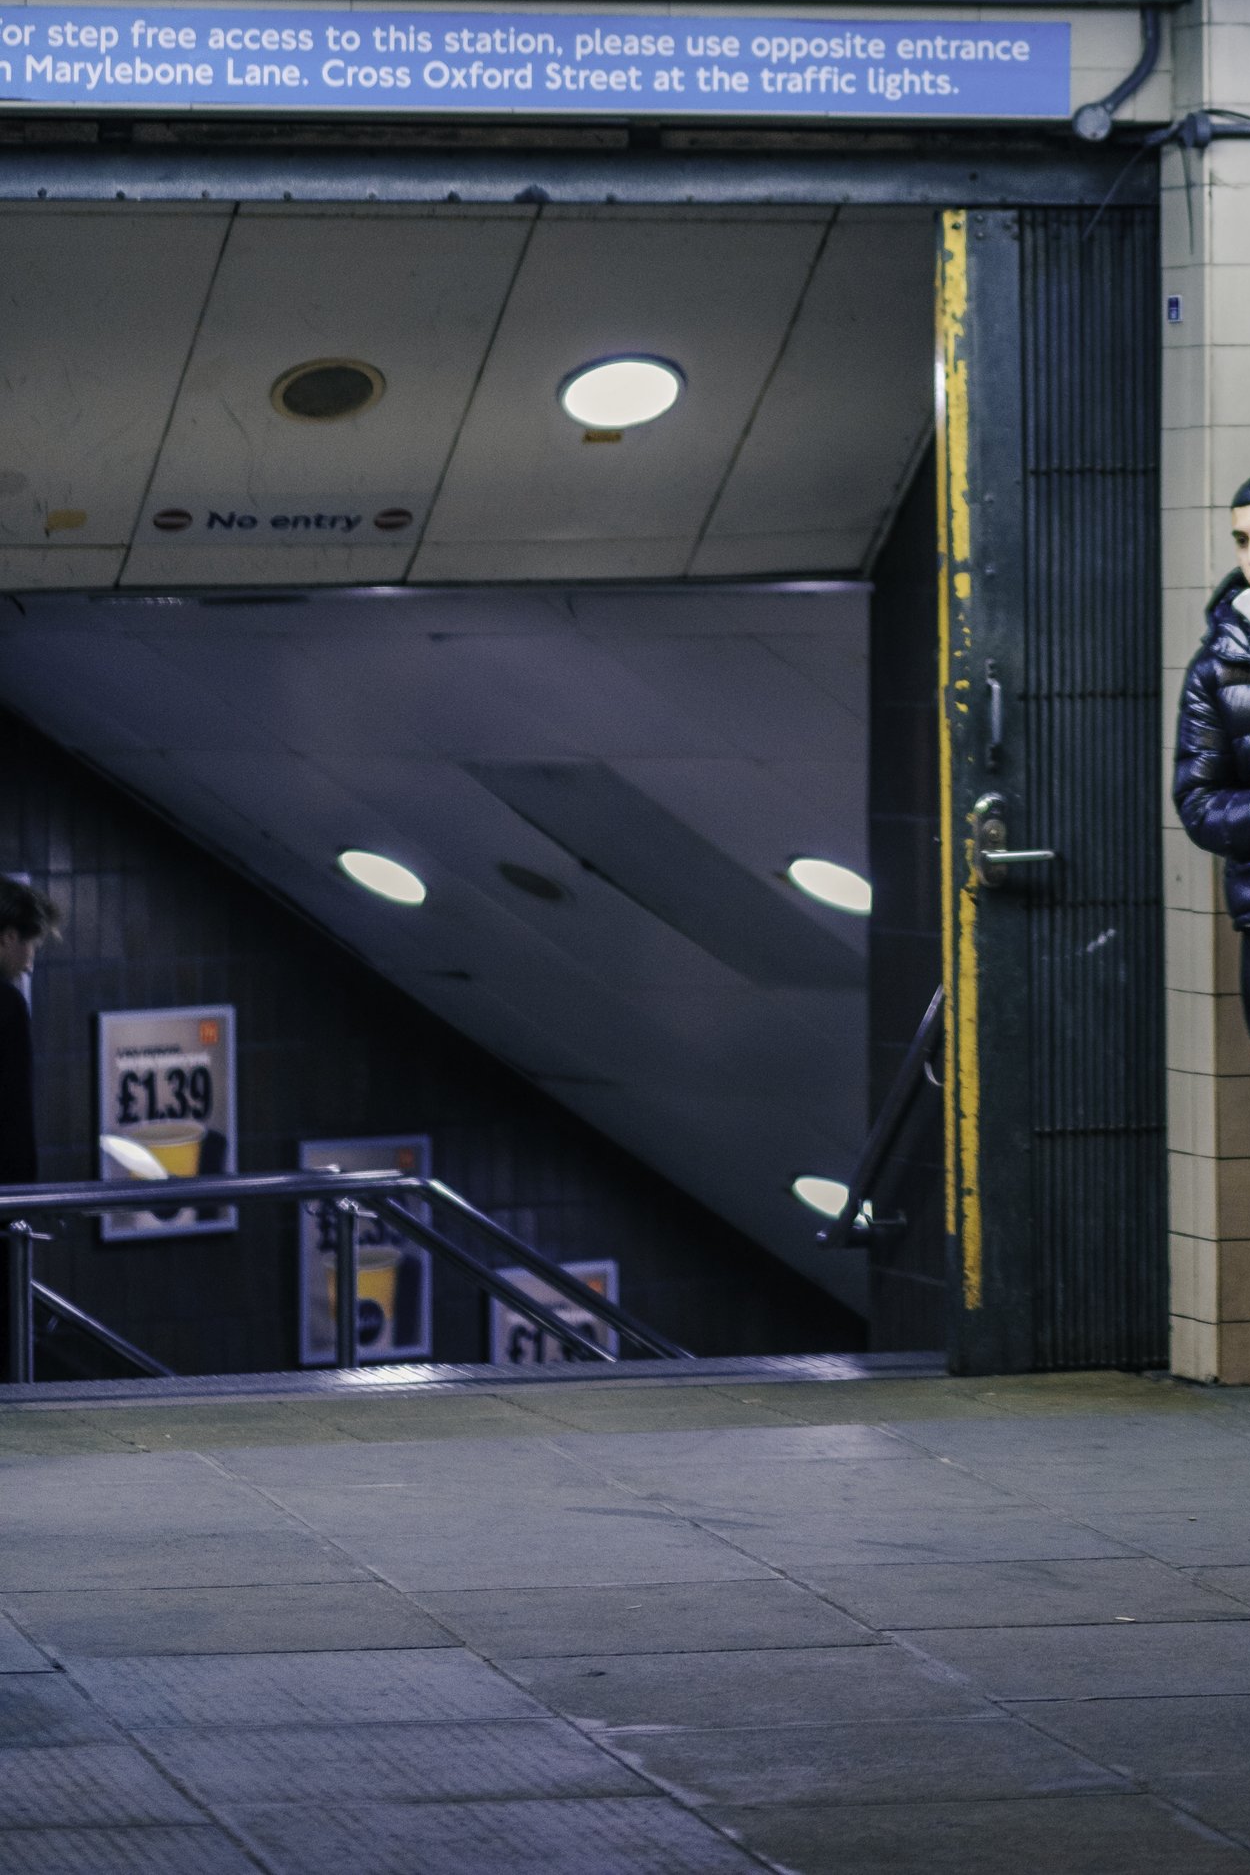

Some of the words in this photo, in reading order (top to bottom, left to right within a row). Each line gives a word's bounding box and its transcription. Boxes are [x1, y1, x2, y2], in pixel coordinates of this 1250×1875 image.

[48, 22, 119, 54] step
[131, 20, 197, 49] free
[208, 27, 314, 51] access
[325, 27, 361, 51] to
[372, 25, 433, 53] this
[444, 27, 563, 58] station,
[575, 28, 675, 62] please
[686, 36, 740, 60] use
[751, 33, 885, 69] opposite
[897, 36, 1029, 62] entrance
[25, 54, 214, 91] Marylebone
[227, 57, 309, 87] Lane.
[321, 59, 411, 88] Cross
[423, 60, 533, 90] Oxford
[545, 62, 642, 91] Street
[653, 67, 685, 92] at
[696, 65, 749, 92] the
[760, 66, 856, 95] traffic
[868, 68, 959, 101] lights.
[205, 510, 258, 531] No
[270, 511, 363, 534] entry
[117, 1064, 213, 1124] £1.39
